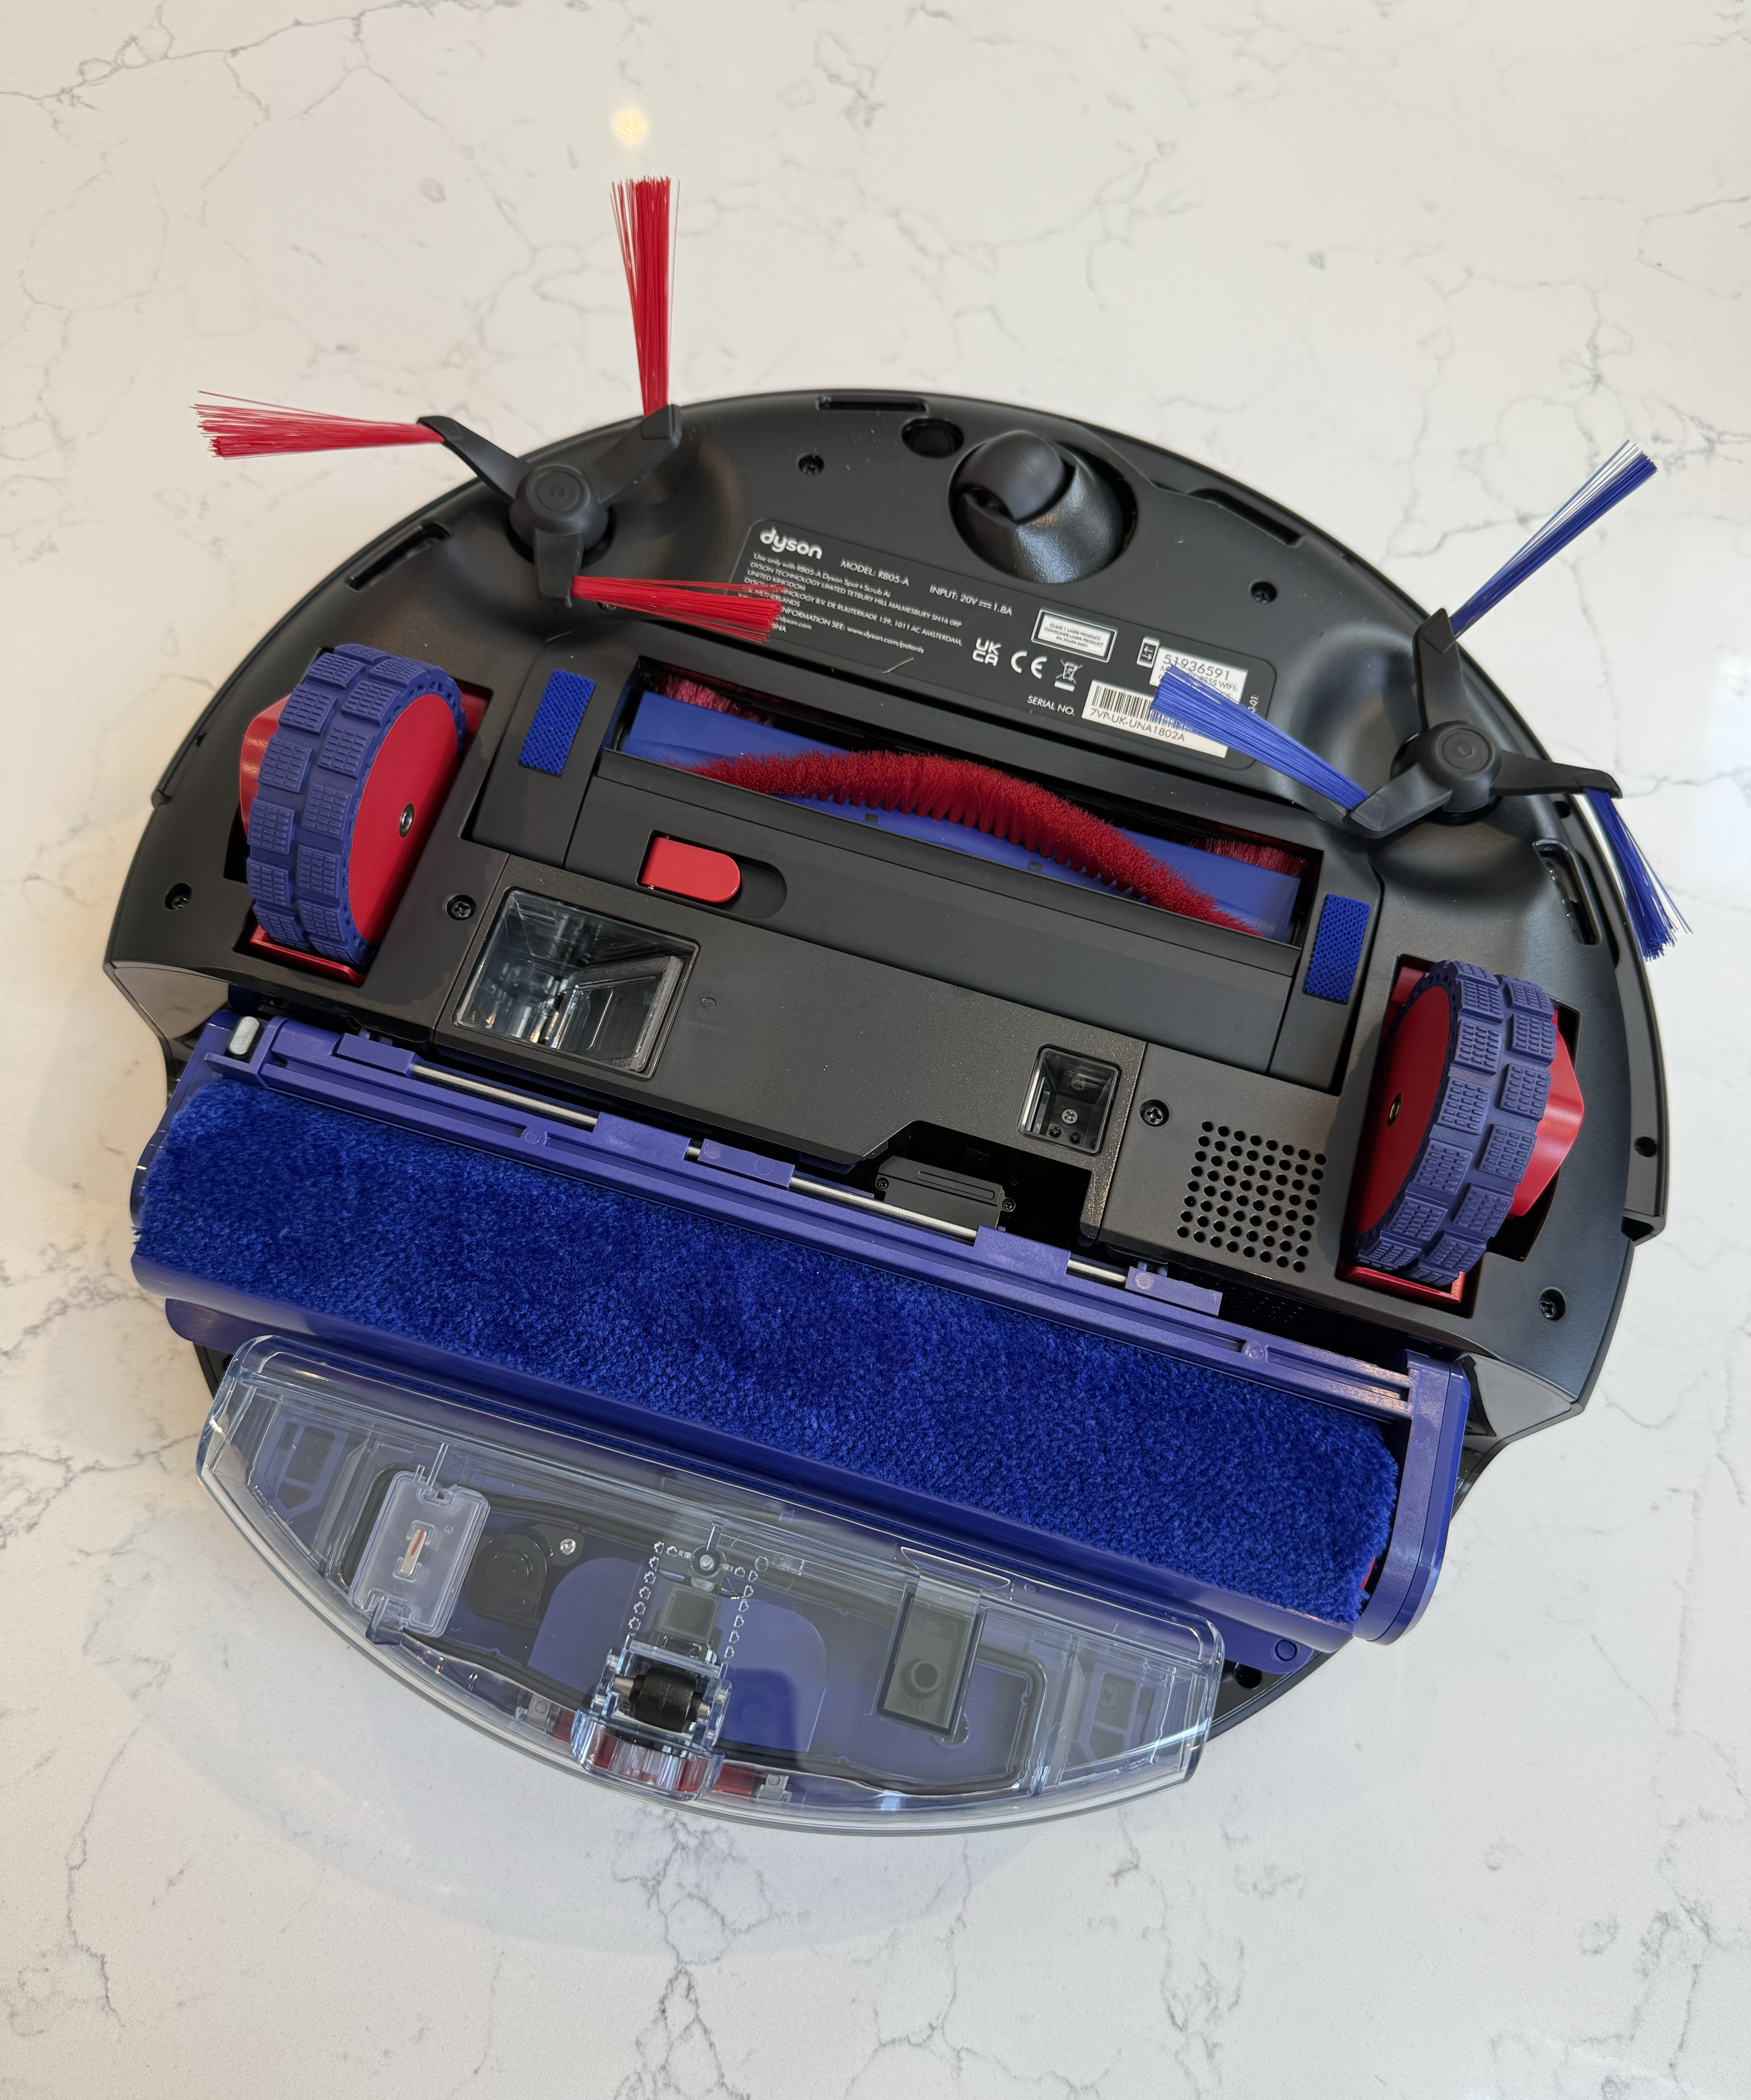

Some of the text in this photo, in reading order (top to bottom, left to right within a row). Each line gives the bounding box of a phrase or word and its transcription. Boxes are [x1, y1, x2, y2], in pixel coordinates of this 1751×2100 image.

[760, 527, 823, 559] dyson
[747, 569, 806, 591] UNITED KINGDOM
[753, 552, 766, 562] Use
[782, 562, 795, 570] with
[822, 572, 843, 584] Dyson
[841, 559, 909, 586] MODEL: RB05-A
[750, 561, 773, 573] DYSON
[775, 568, 821, 587] TECHNOLOGY
[821, 583, 846, 594] LIMITED
[847, 589, 874, 602] TETBURY
[874, 597, 887, 607] HILL
[931, 613, 949, 624] SN16
[929, 584, 958, 600] INPUT:
[994, 602, 1012, 616] 1.8A
[781, 606, 831, 626] NFORMATION
[831, 618, 845, 631] SEE:
[827, 601, 837, 609] DE
[879, 615, 892, 626] 139,
[895, 620, 910, 631] 1011
[910, 624, 921, 633] AC
[976, 637, 1001, 655] UK
[1044, 627, 1069, 638] CONSUMER
[1082, 638, 1104, 647] PRODUCT
[1080, 632, 1101, 641] PRODUCT
[972, 649, 998, 666] CA
[1163, 655, 1229, 680] 51936591
[1027, 695, 1075, 716] SERIAL NO.
[1090, 708, 1185, 742] 7VP-UK-UNA1802A
